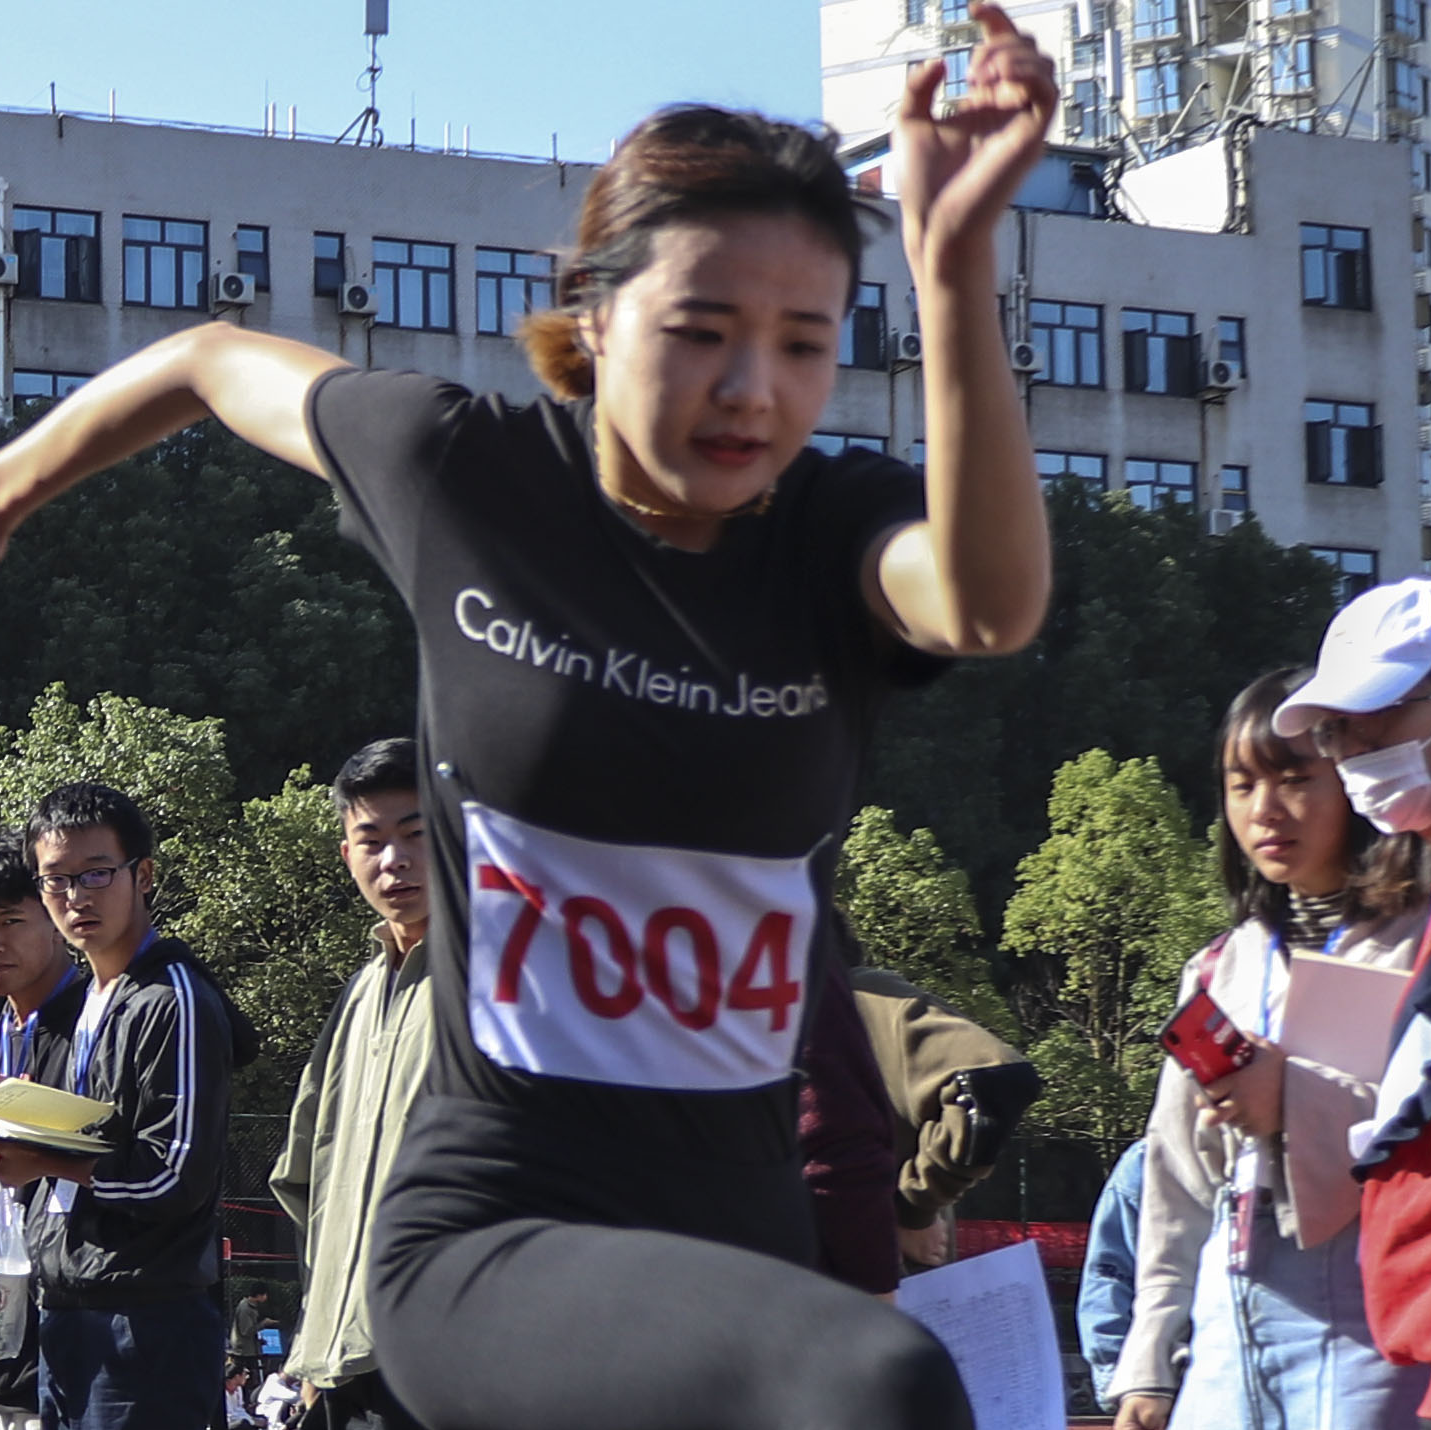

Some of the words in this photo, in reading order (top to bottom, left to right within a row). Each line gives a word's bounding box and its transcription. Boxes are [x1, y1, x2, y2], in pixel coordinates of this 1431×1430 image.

[455, 588, 593, 682] Calvin
[602, 648, 718, 714] Klein
[479, 865, 801, 1032] 7004
